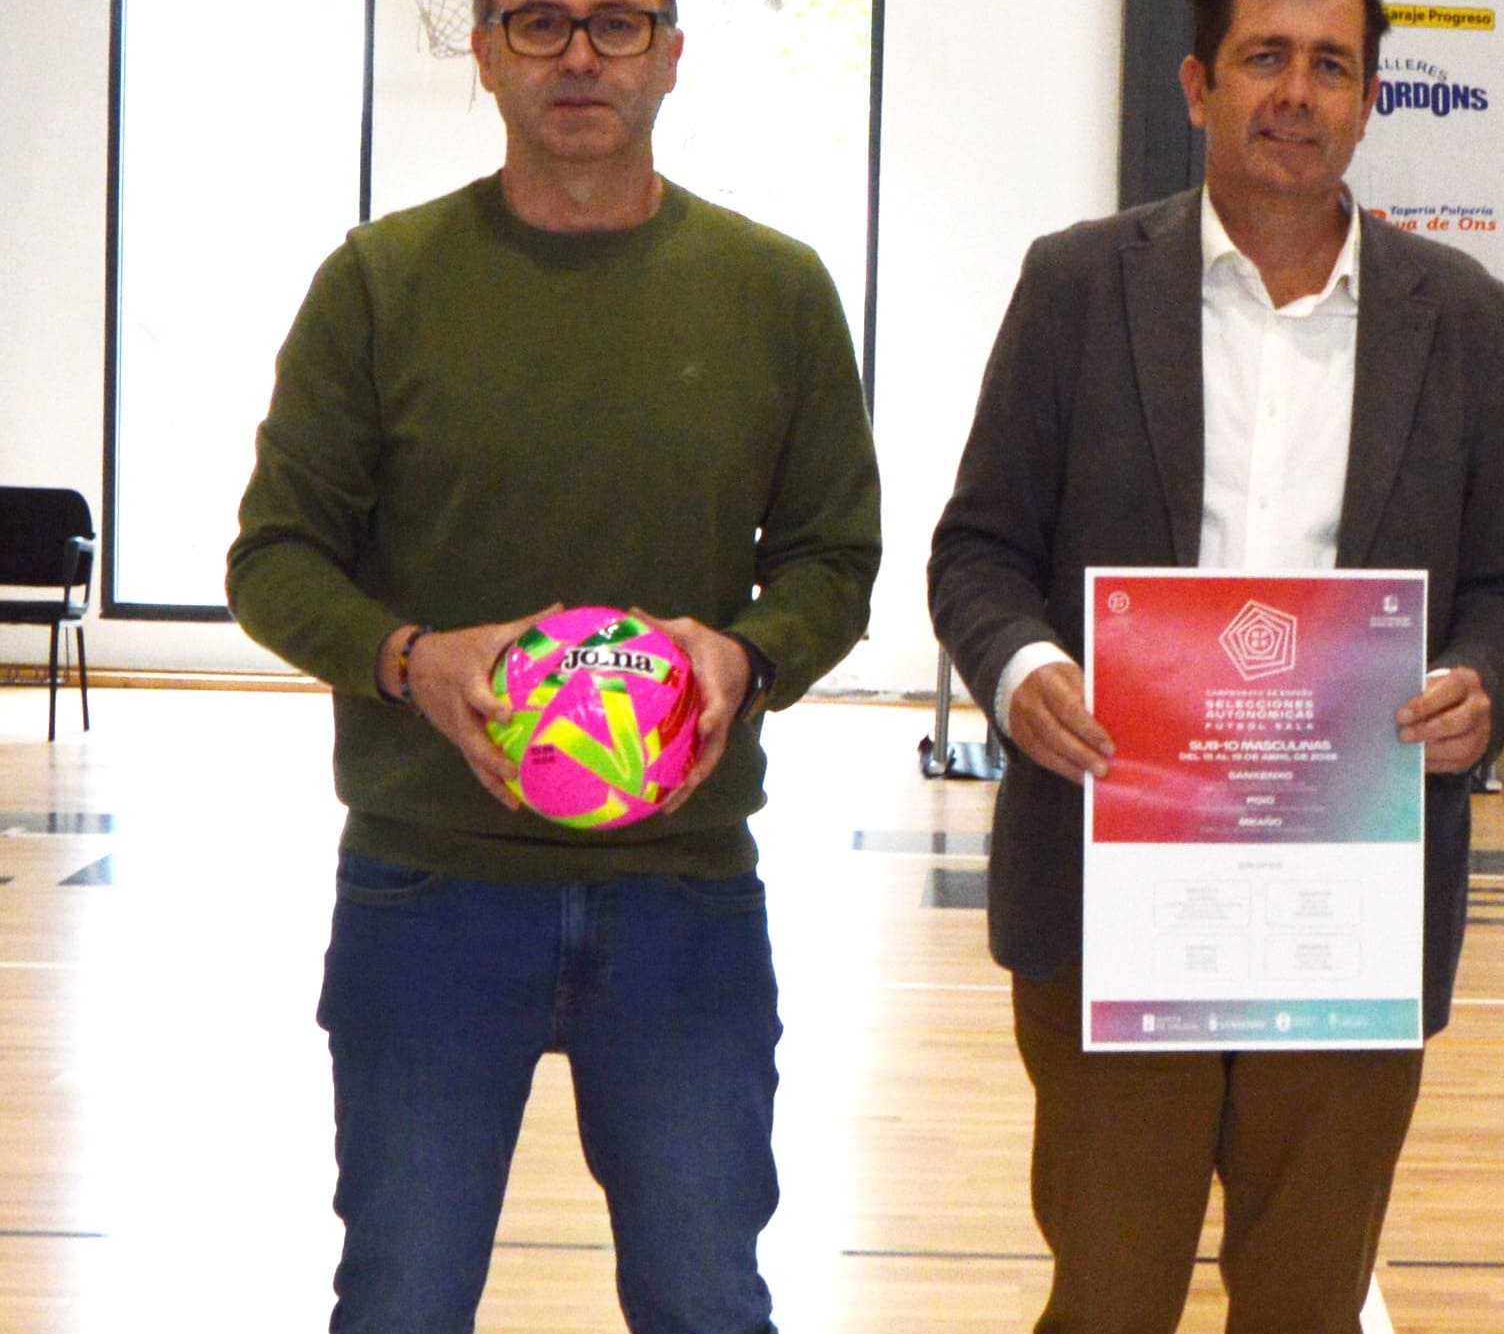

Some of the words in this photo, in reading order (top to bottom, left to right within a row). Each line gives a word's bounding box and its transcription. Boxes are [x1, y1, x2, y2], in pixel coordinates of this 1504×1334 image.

[1428, 9, 1491, 27] Progreso
[1458, 217, 1497, 231] Ons
[1240, 740, 1333, 752] MASCULINAS
